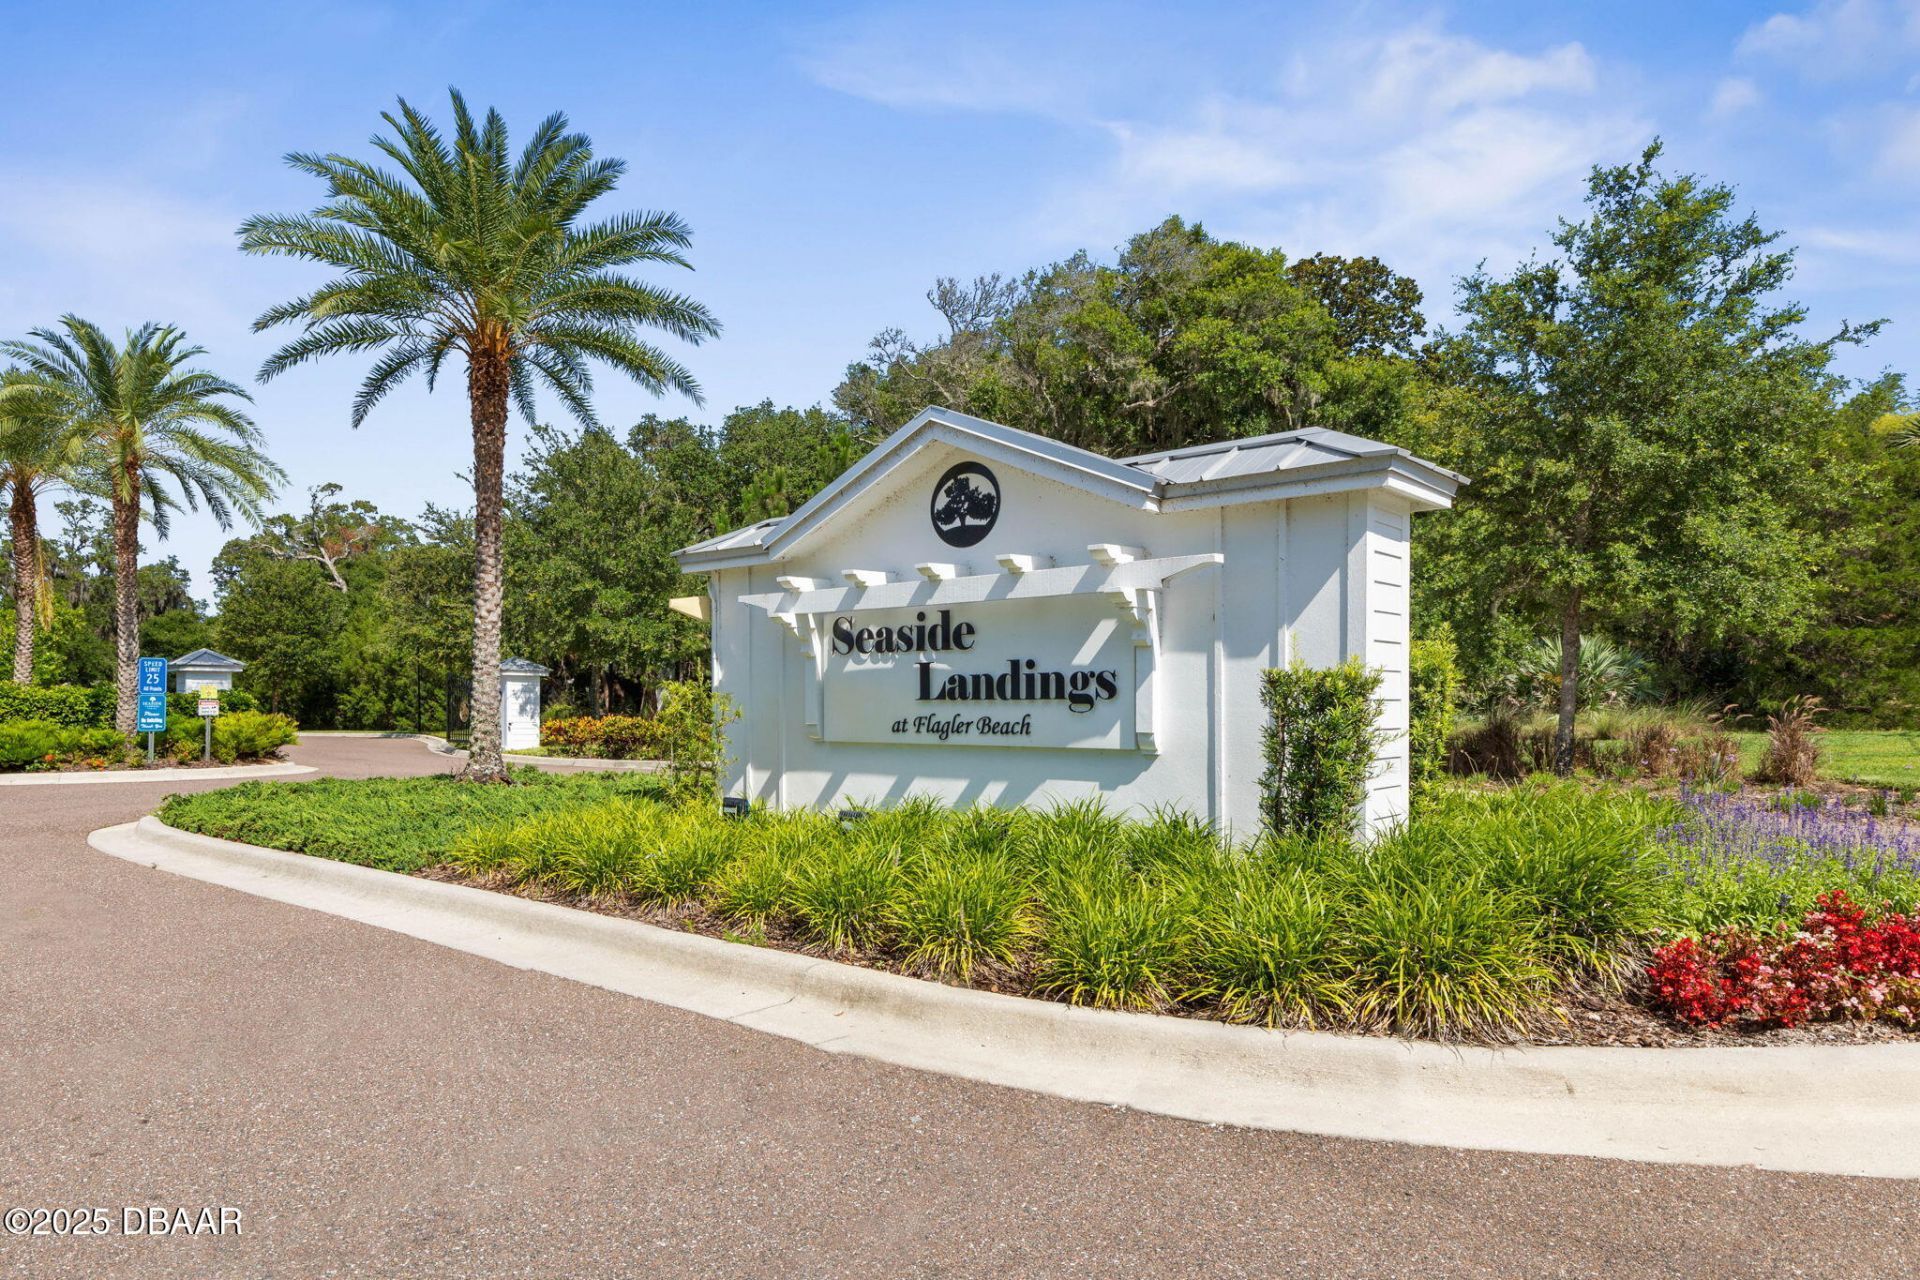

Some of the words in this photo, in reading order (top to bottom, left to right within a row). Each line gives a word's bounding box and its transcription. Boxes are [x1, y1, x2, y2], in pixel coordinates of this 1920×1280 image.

[832, 609, 975, 655] Seaside
[146, 674, 159, 684] 25
[914, 659, 1118, 714] Landings
[891, 717, 908, 734] at
[913, 713, 974, 741] Flagler
[976, 713, 1032, 736] Beach
